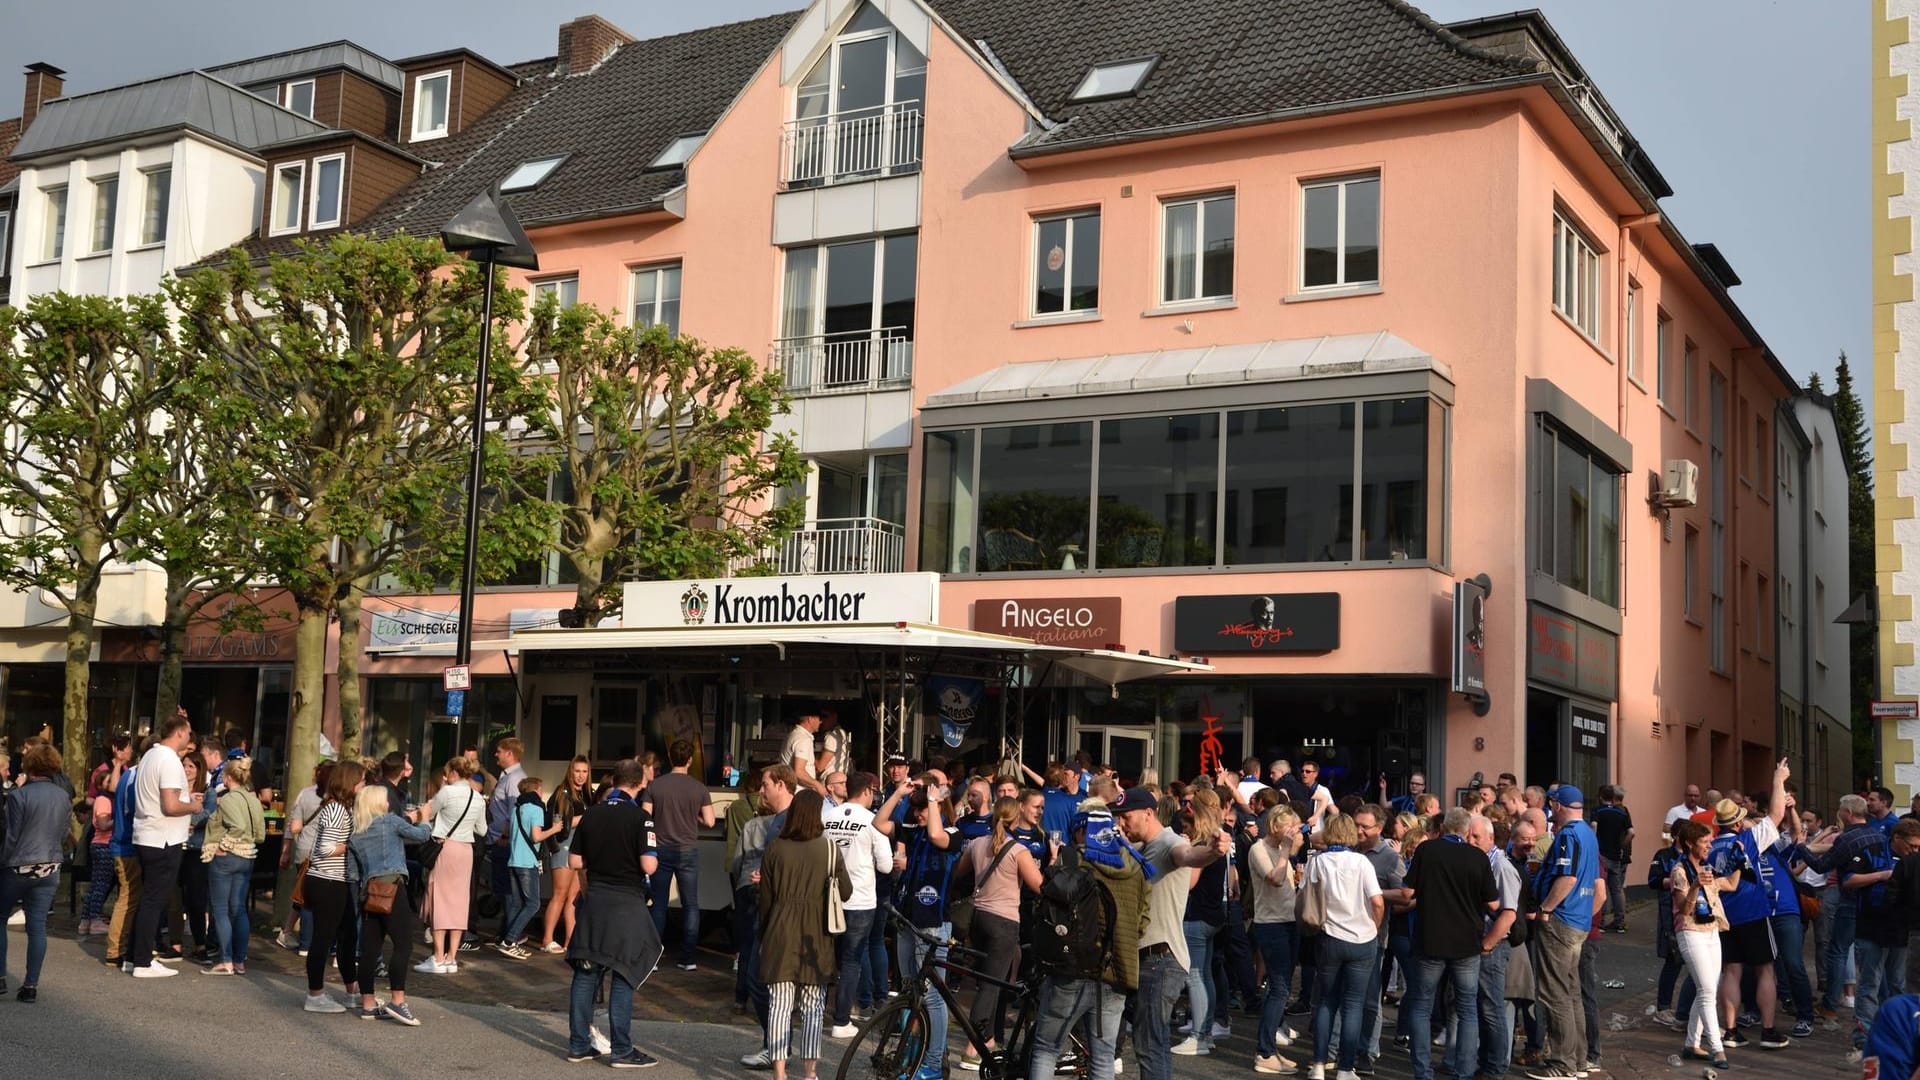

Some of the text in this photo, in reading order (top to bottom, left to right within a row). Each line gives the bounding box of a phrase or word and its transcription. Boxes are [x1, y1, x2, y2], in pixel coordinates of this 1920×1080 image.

[714, 581, 866, 624] Krombacher
[377, 620, 399, 637] Eis
[1474, 737, 1485, 751] 8
[824, 820, 867, 831] saller
